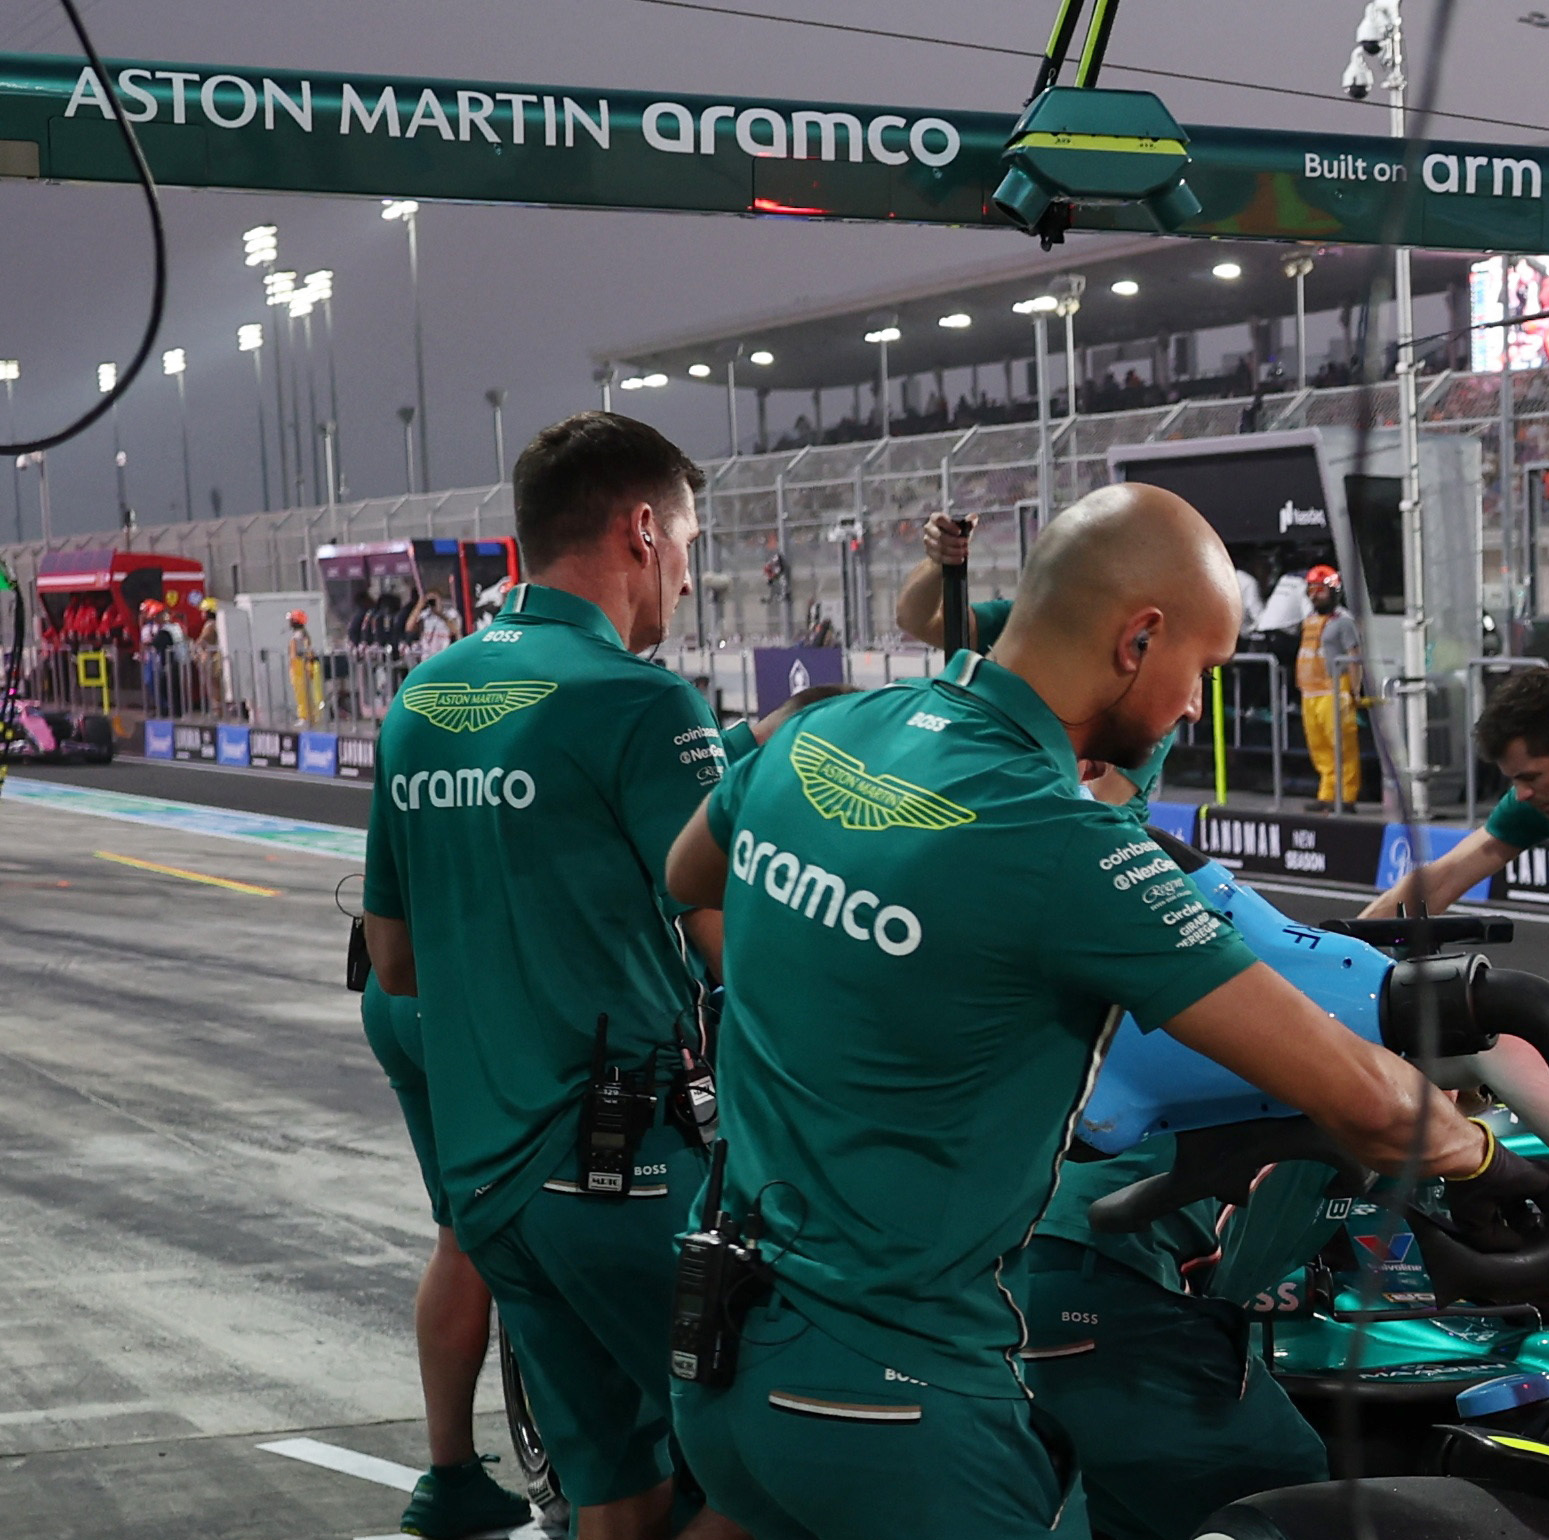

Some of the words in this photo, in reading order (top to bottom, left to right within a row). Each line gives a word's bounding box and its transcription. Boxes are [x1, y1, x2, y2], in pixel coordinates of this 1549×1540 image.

[64, 65, 315, 133] ASTON
[338, 81, 611, 151] MARTIN
[640, 100, 962, 168] aramco
[1303, 151, 1368, 182] Built
[1372, 161, 1408, 184] on
[1421, 151, 1543, 199] arm
[481, 629, 524, 644] BOSS
[437, 692, 470, 707] ASTON
[905, 711, 952, 733] BOSS
[821, 762, 859, 790] ASTON
[391, 766, 537, 812] aramco
[1200, 816, 1281, 858] LANDMAN
[1292, 830, 1317, 850] NEW
[1283, 848, 1327, 872] SEASON
[732, 828, 923, 957] aramco
[633, 1163, 668, 1177] BOSS
[1060, 1310, 1099, 1326] BOSS
